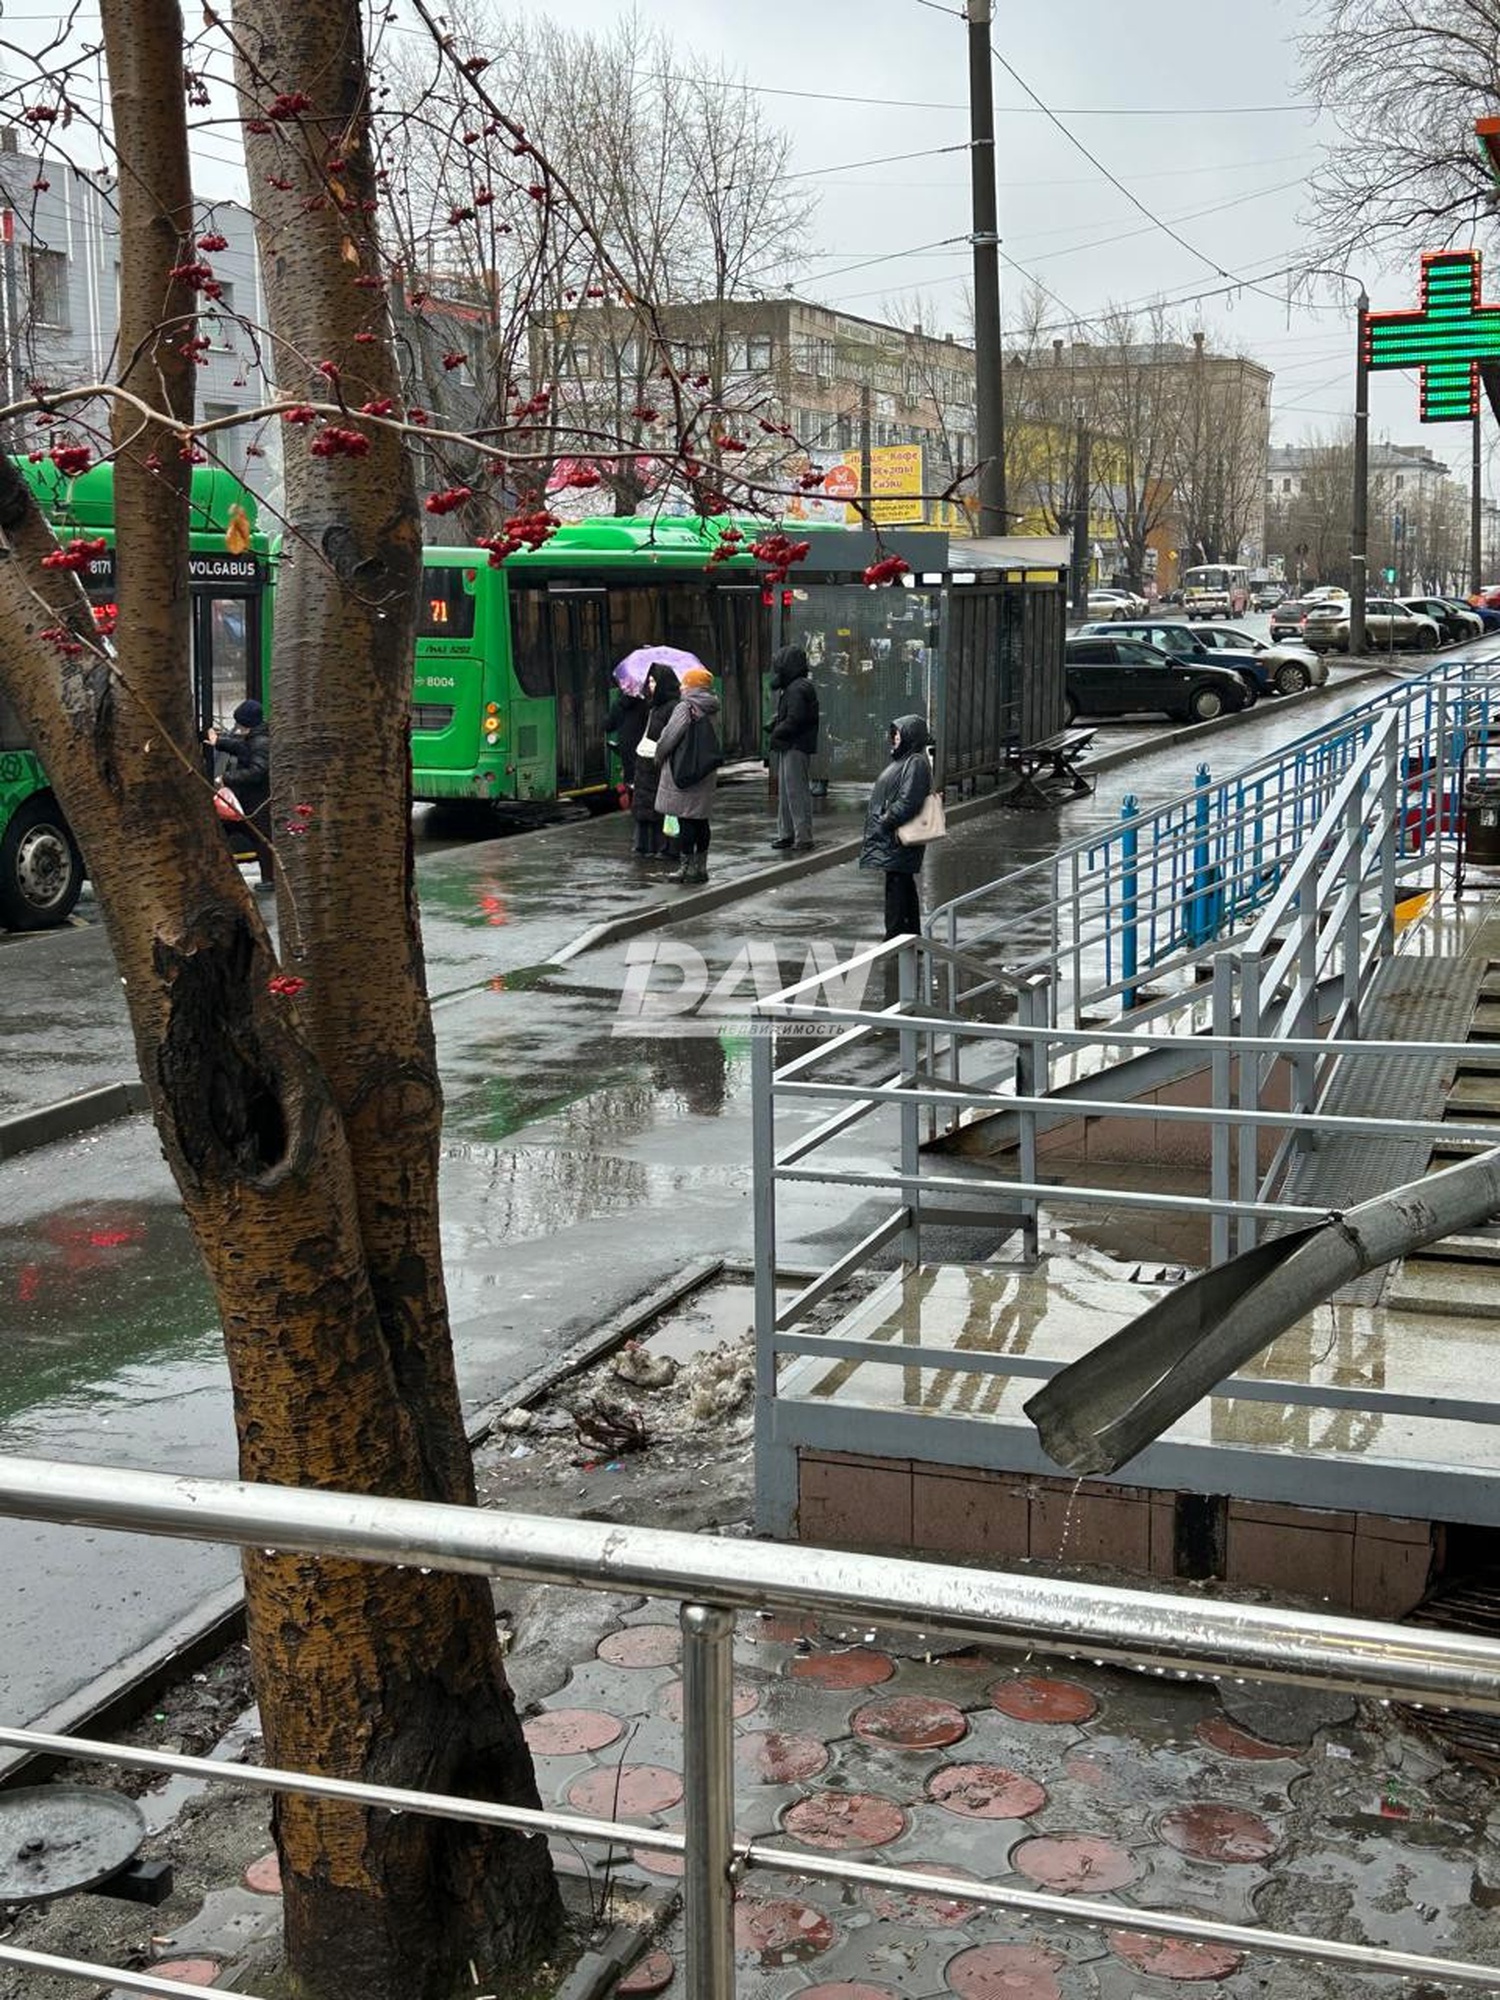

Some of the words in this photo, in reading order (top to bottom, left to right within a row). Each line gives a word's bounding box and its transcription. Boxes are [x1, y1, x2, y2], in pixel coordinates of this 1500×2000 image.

[188, 561, 256, 576] VOLGABUS
[430, 600, 448, 622] 71
[426, 676, 455, 687] 8004
